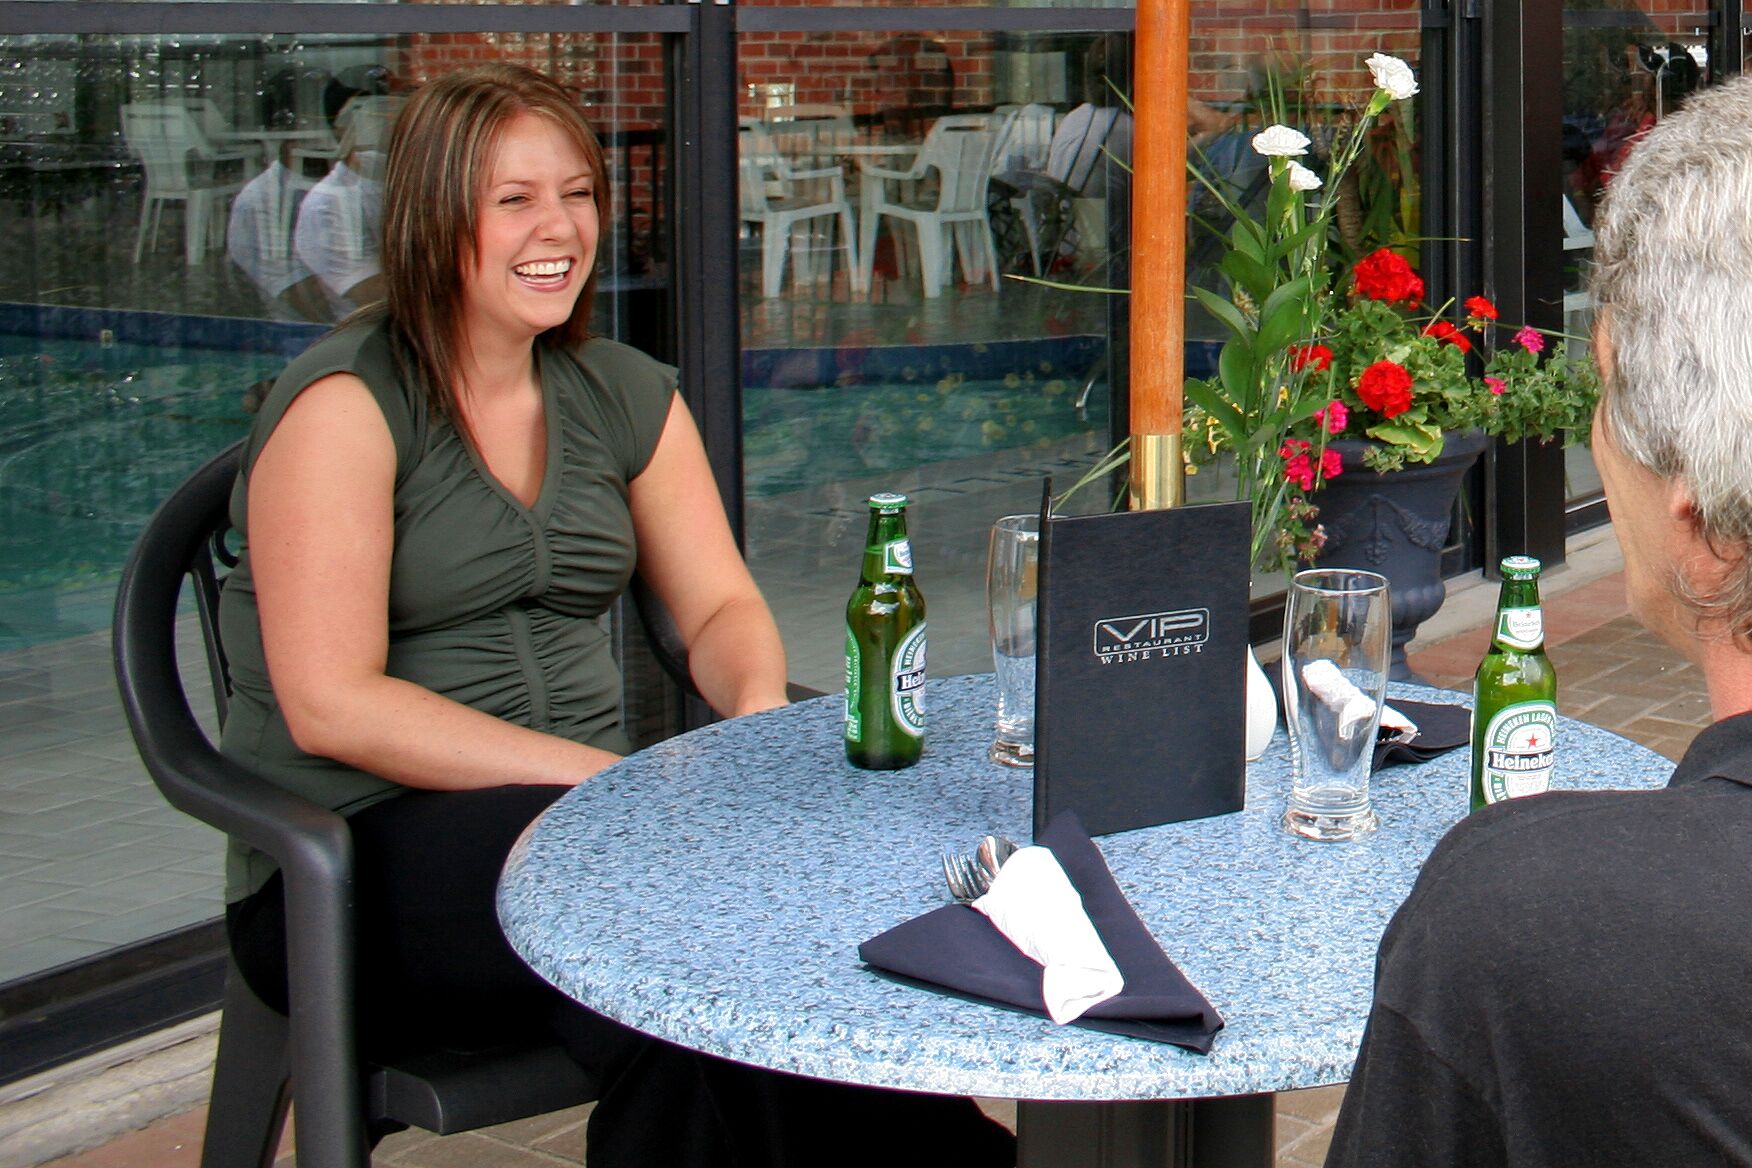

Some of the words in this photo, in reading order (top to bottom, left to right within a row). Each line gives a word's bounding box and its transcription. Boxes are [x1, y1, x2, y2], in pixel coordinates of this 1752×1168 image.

[806, 449, 1106, 518] SHALLW
[1102, 613, 1204, 642] VIP
[1101, 634, 1202, 652] RESTAURANT
[1100, 651, 1151, 665] WINE
[1162, 644, 1203, 657] LIST
[1492, 752, 1554, 771] Heineke
